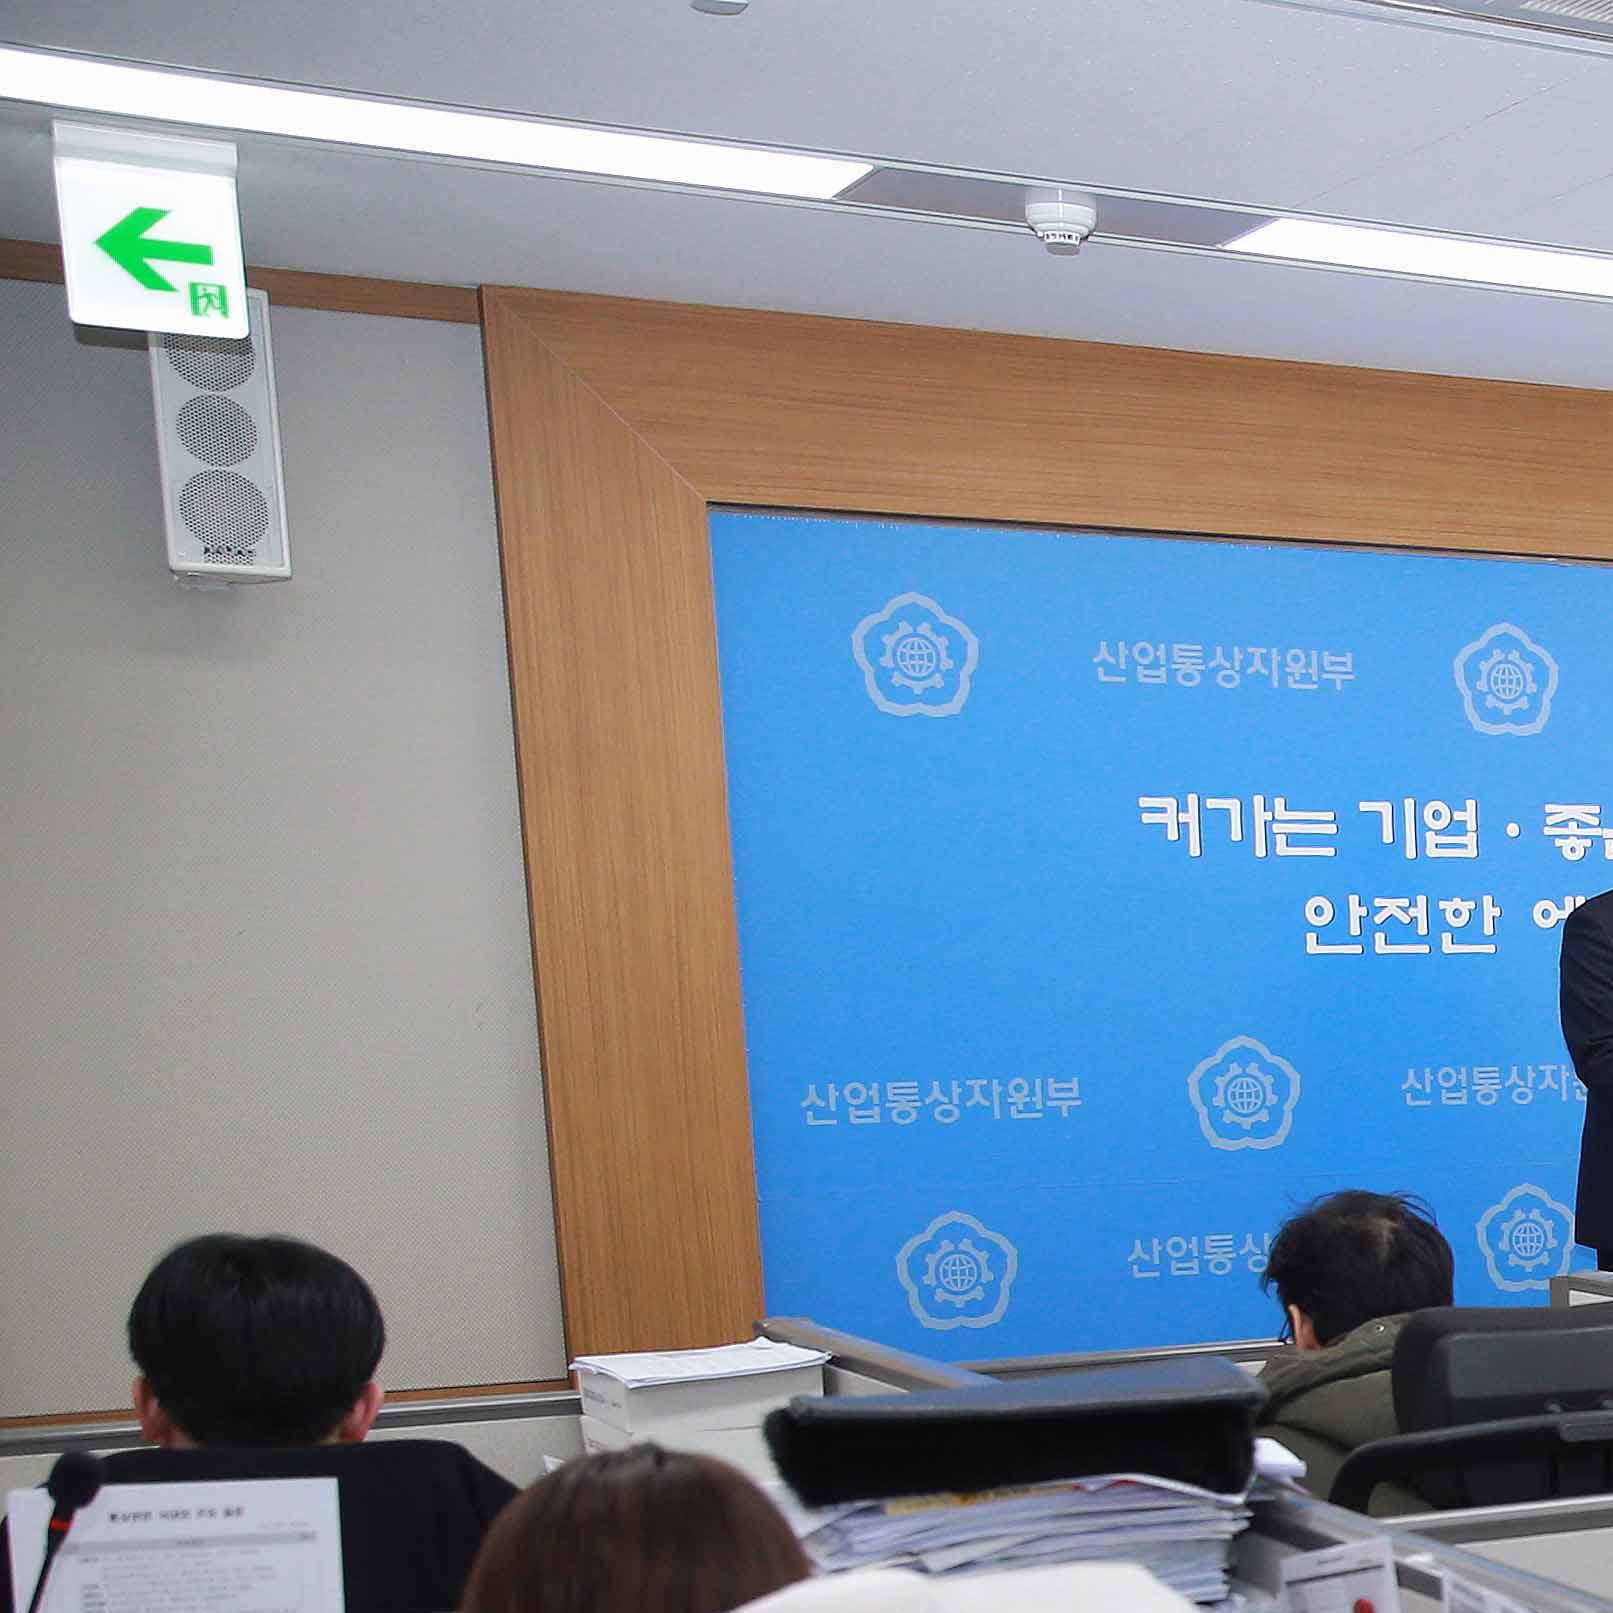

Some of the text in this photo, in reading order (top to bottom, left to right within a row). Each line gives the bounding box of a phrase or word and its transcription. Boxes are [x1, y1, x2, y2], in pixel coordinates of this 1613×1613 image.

[1092, 640, 1355, 692] 산업통상자원부
[1138, 793, 1339, 858] 커가는
[1359, 797, 1480, 860] 기업
[1305, 894, 1501, 956] 안전한
[800, 1077, 1083, 1127] 산업통상자원부
[1401, 1064, 1587, 1107] 산업통상자
[1127, 1232, 1271, 1280] 산업통상
